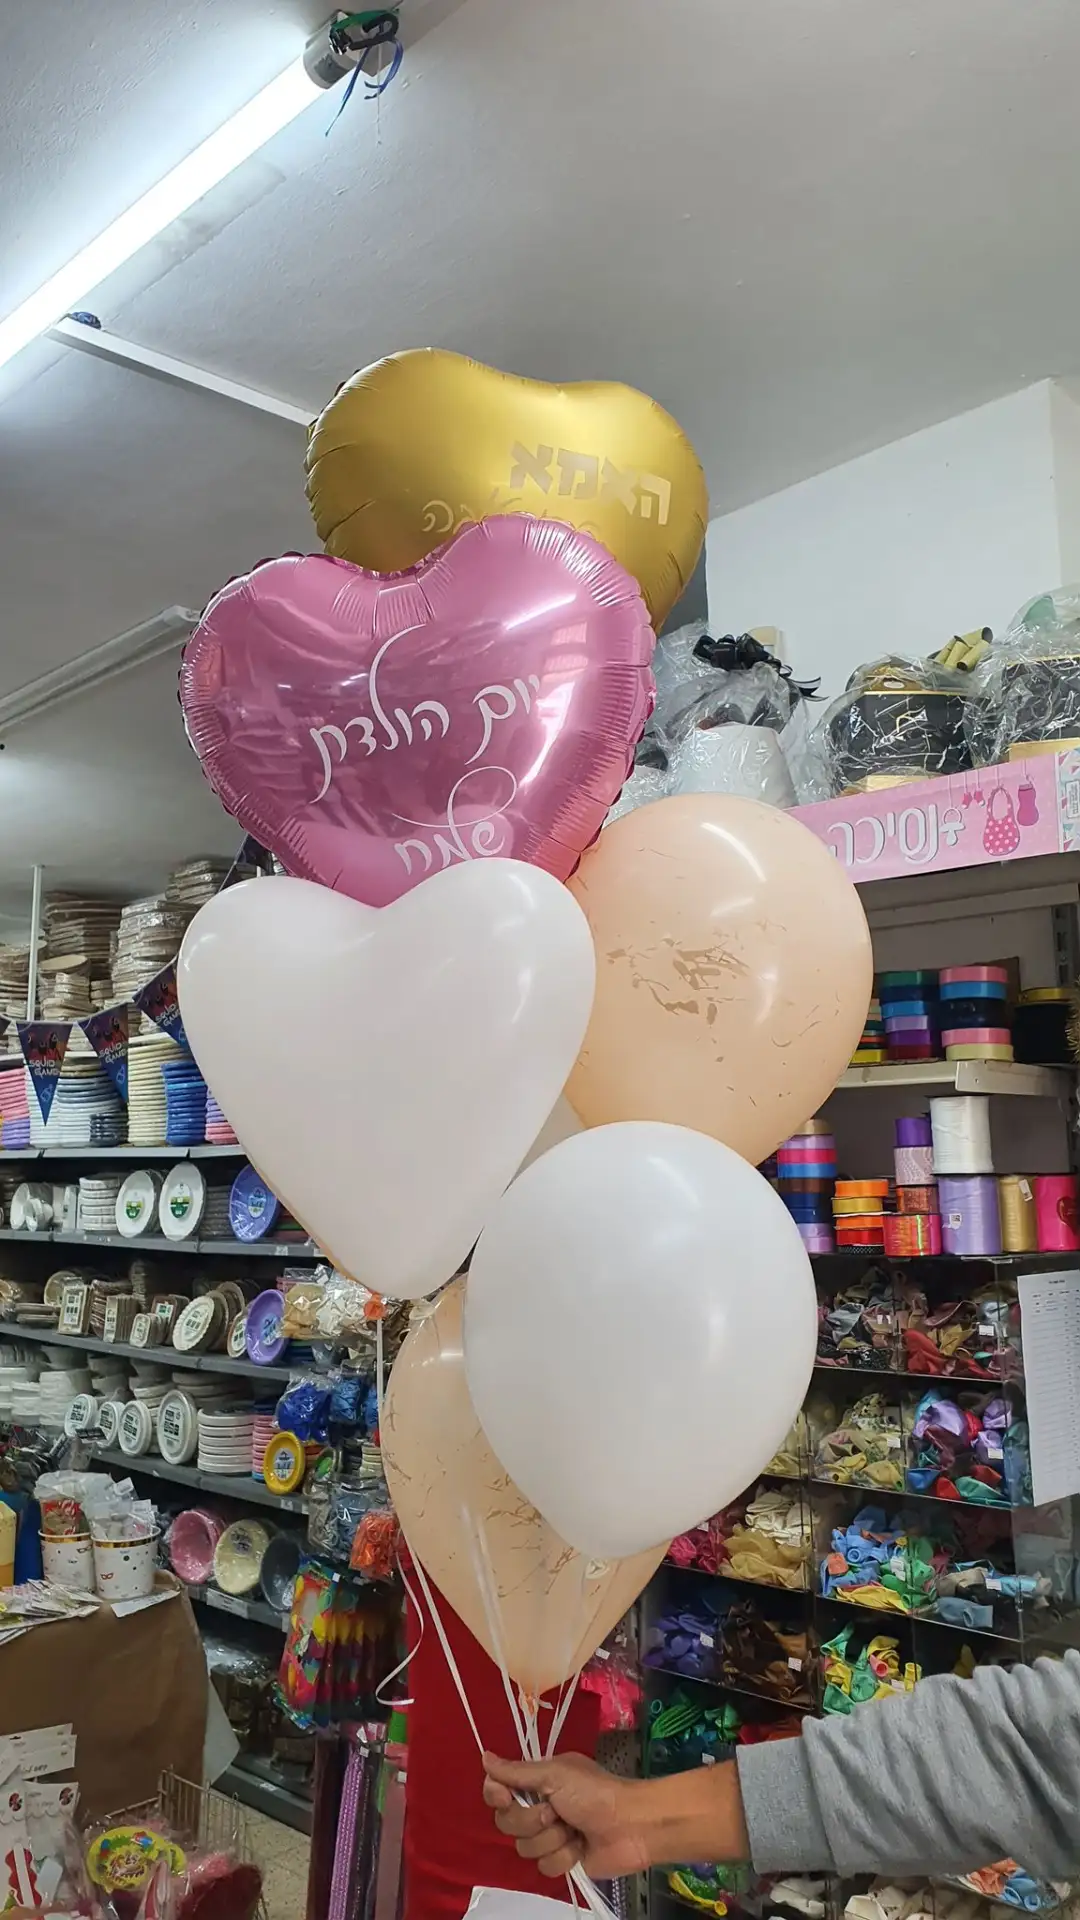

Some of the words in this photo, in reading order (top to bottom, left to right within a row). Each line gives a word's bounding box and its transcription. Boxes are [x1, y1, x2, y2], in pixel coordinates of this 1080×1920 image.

[509, 440, 672, 526] האמא
[309, 623, 450, 805] הולדת
[465, 673, 541, 766] יום
[391, 765, 518, 877] שמח
[155, 1003, 177, 1024] SQUID
[98, 1041, 123, 1059] SQUID
[105, 1050, 128, 1064] GAME
[29, 1056, 56, 1068] SQUID
[34, 1065, 61, 1079] GAME
